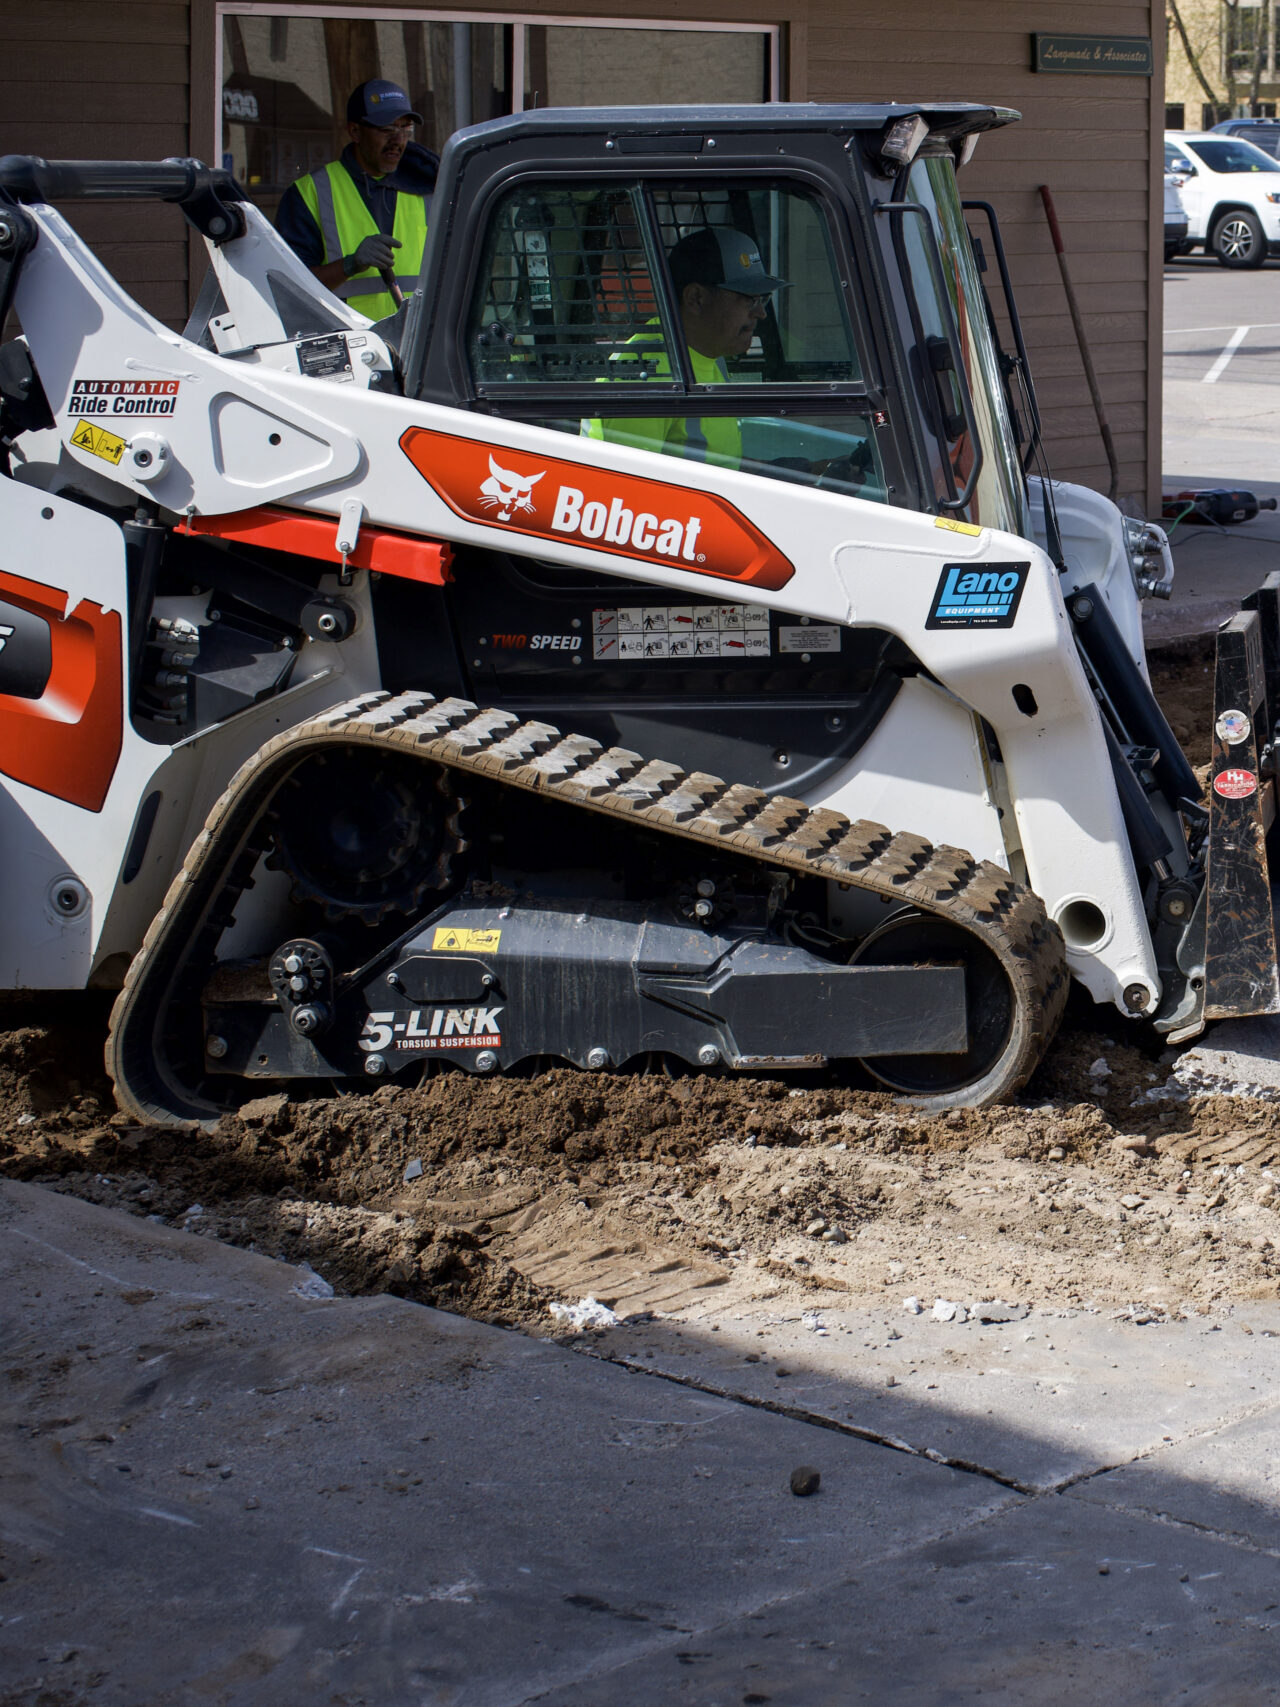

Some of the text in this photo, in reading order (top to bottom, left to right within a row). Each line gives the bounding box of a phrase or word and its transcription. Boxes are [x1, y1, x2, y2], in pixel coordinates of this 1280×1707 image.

[1043, 44, 1147, 63] Langmade & Associates
[76, 382, 176, 393] AUTOMATIC
[68, 396, 177, 413] Ride Control
[939, 568, 1020, 605] Lano
[492, 634, 582, 650] TWO SPEED
[358, 1007, 505, 1052] 5-LINK
[397, 1036, 499, 1049] TORSION SUSPENSION
